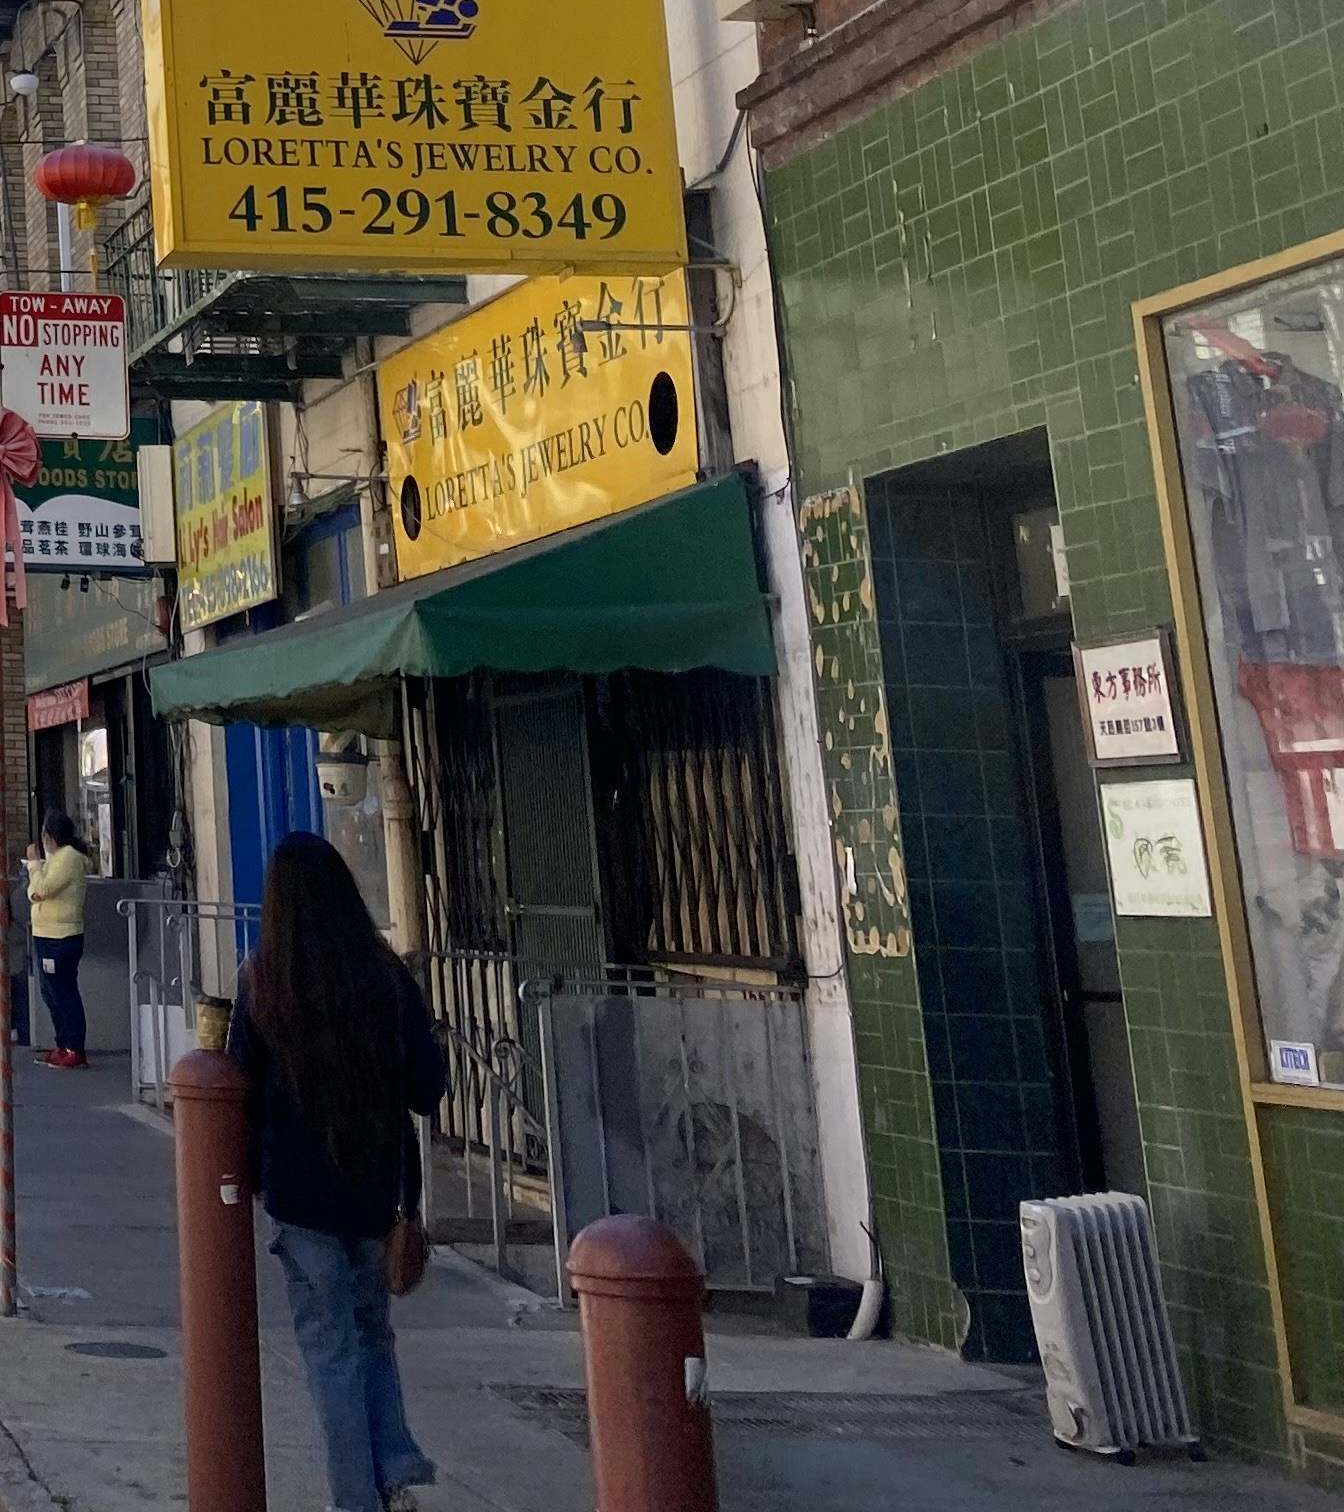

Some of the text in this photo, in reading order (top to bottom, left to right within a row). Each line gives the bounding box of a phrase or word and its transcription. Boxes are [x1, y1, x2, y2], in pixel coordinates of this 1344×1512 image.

[199, 69, 642, 134] 富麗華珠寶金行
[201, 137, 654, 178] LORETTA'S JEWELRY CO.
[228, 185, 627, 241] 415-291-8349
[10, 296, 45, 313] TOW
[62, 298, 112, 315] AWAY
[3, 314, 119, 348] NO STOPPING
[40, 354, 85, 377] ANY
[425, 277, 665, 446] 富麗華珠寶金行
[37, 382, 91, 407] TIME
[38, 467, 87, 488] OODS
[425, 399, 650, 521] LORETTA'S JEWELRY CO.
[232, 487, 264, 541] Salon
